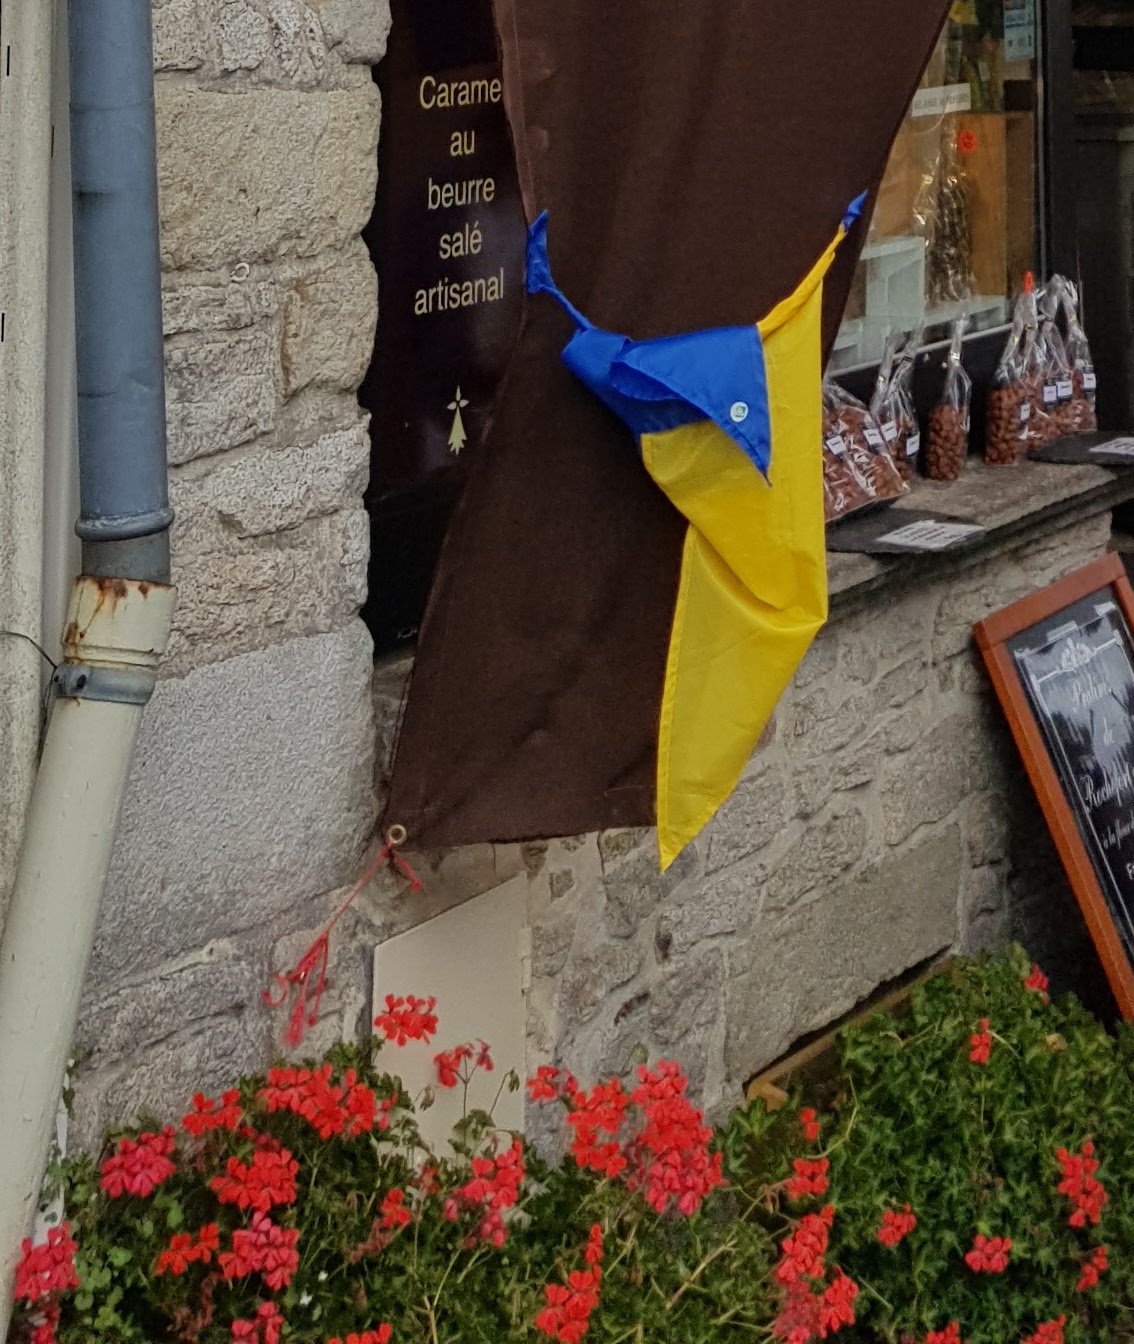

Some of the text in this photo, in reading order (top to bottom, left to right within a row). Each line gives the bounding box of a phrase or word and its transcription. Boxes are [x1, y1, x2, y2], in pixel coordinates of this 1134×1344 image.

[420, 75, 502, 109] Carame
[450, 130, 475, 157] au
[428, 177, 496, 210] beurre
[440, 220, 482, 259] salé
[414, 267, 504, 315] artisanal
